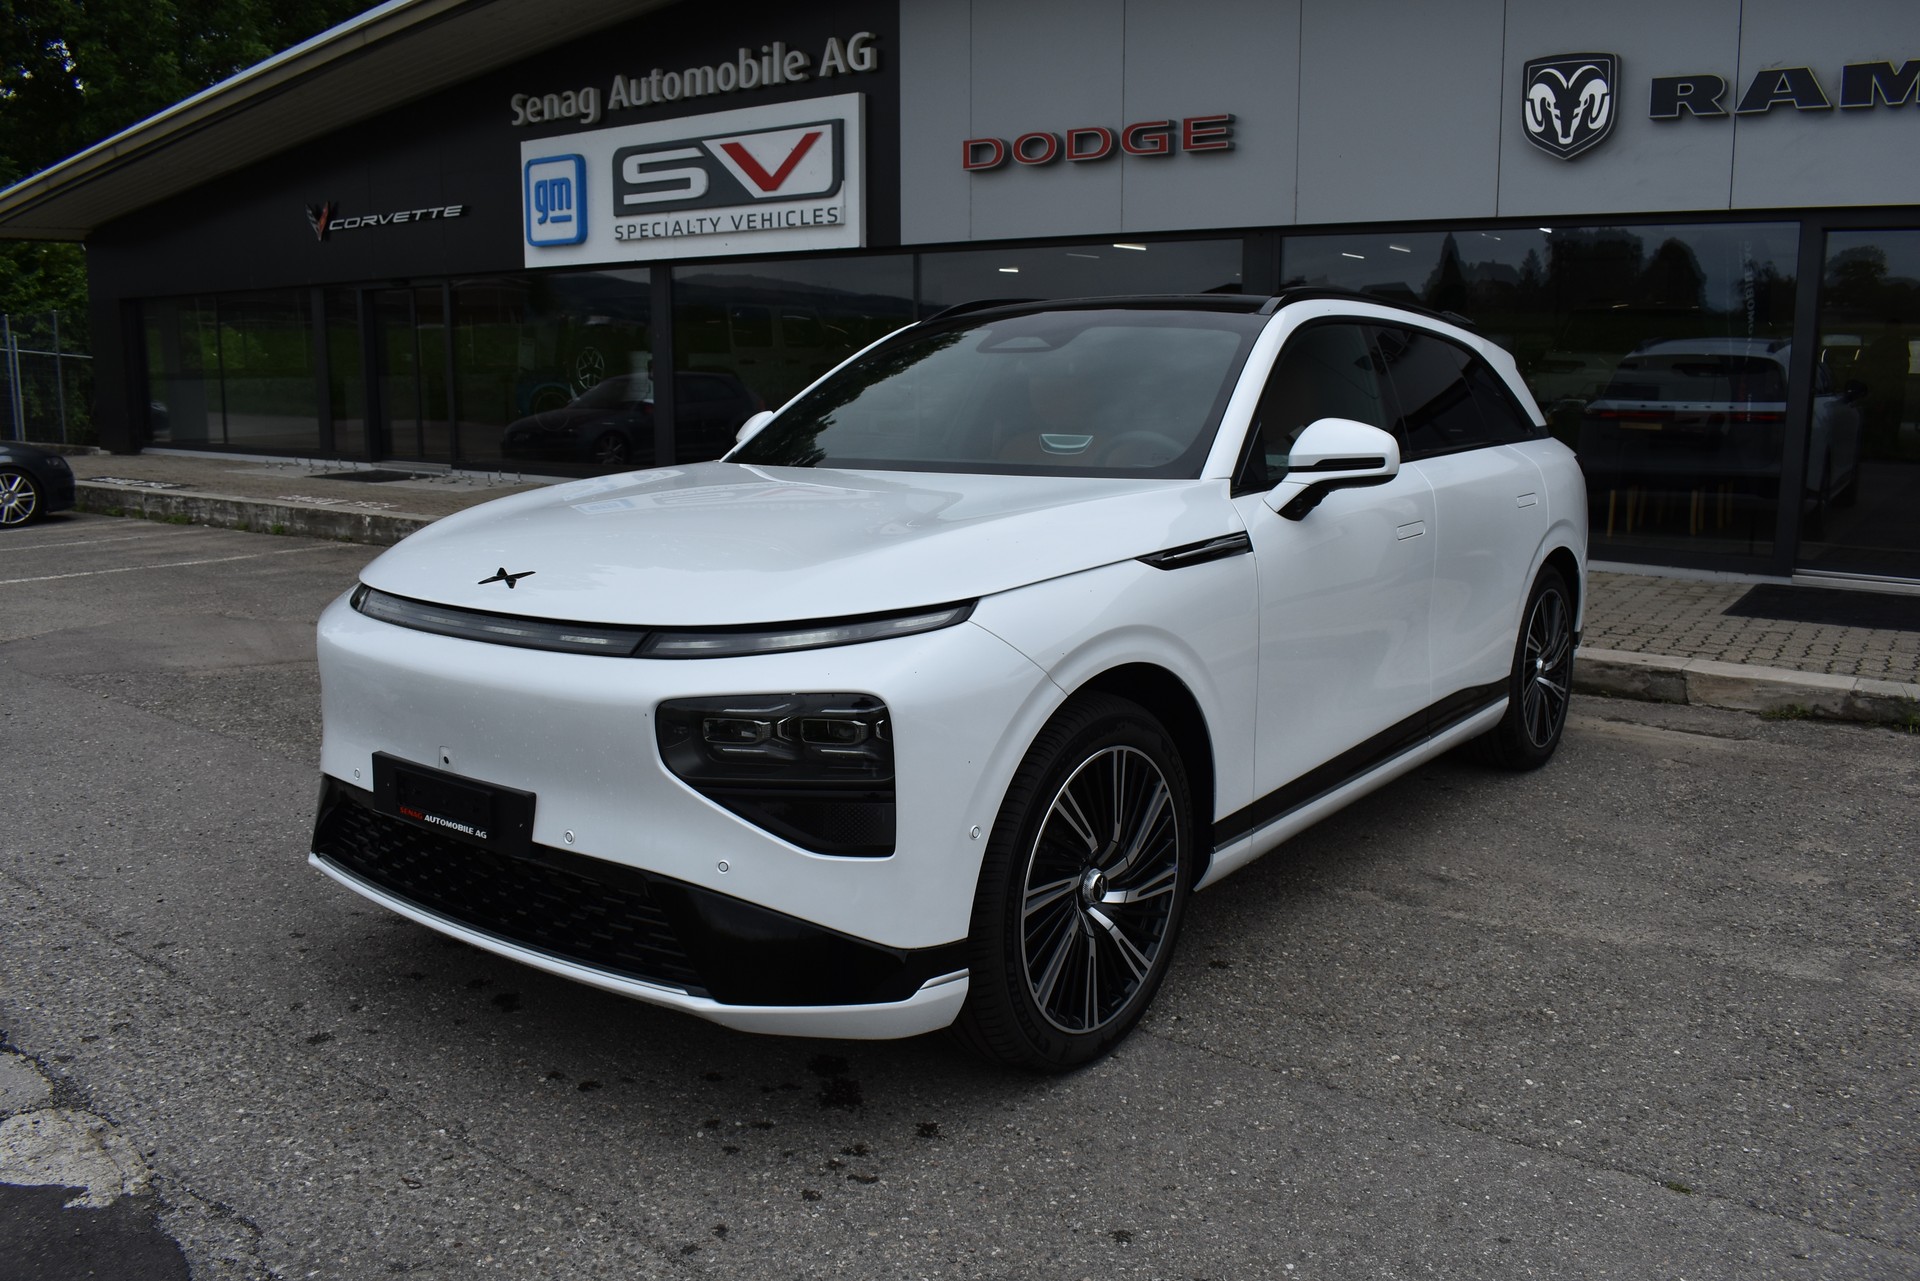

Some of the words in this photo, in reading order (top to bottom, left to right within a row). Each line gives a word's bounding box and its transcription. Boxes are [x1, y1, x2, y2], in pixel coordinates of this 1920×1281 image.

[511, 87, 599, 126] Senag
[608, 41, 809, 110] Automobile
[819, 32, 876, 76] AG
[1649, 59, 1920, 119] RAM
[963, 113, 1234, 171] DODGE
[329, 204, 463, 231] CORVETTE
[534, 177, 572, 225] gm
[615, 216, 721, 240] SPECIALTY
[731, 207, 838, 231] VEHICLES
[399, 806, 424, 821] SENAG
[424, 814, 474, 835] AUTOMOBILE
[475, 830, 488, 839] AG
